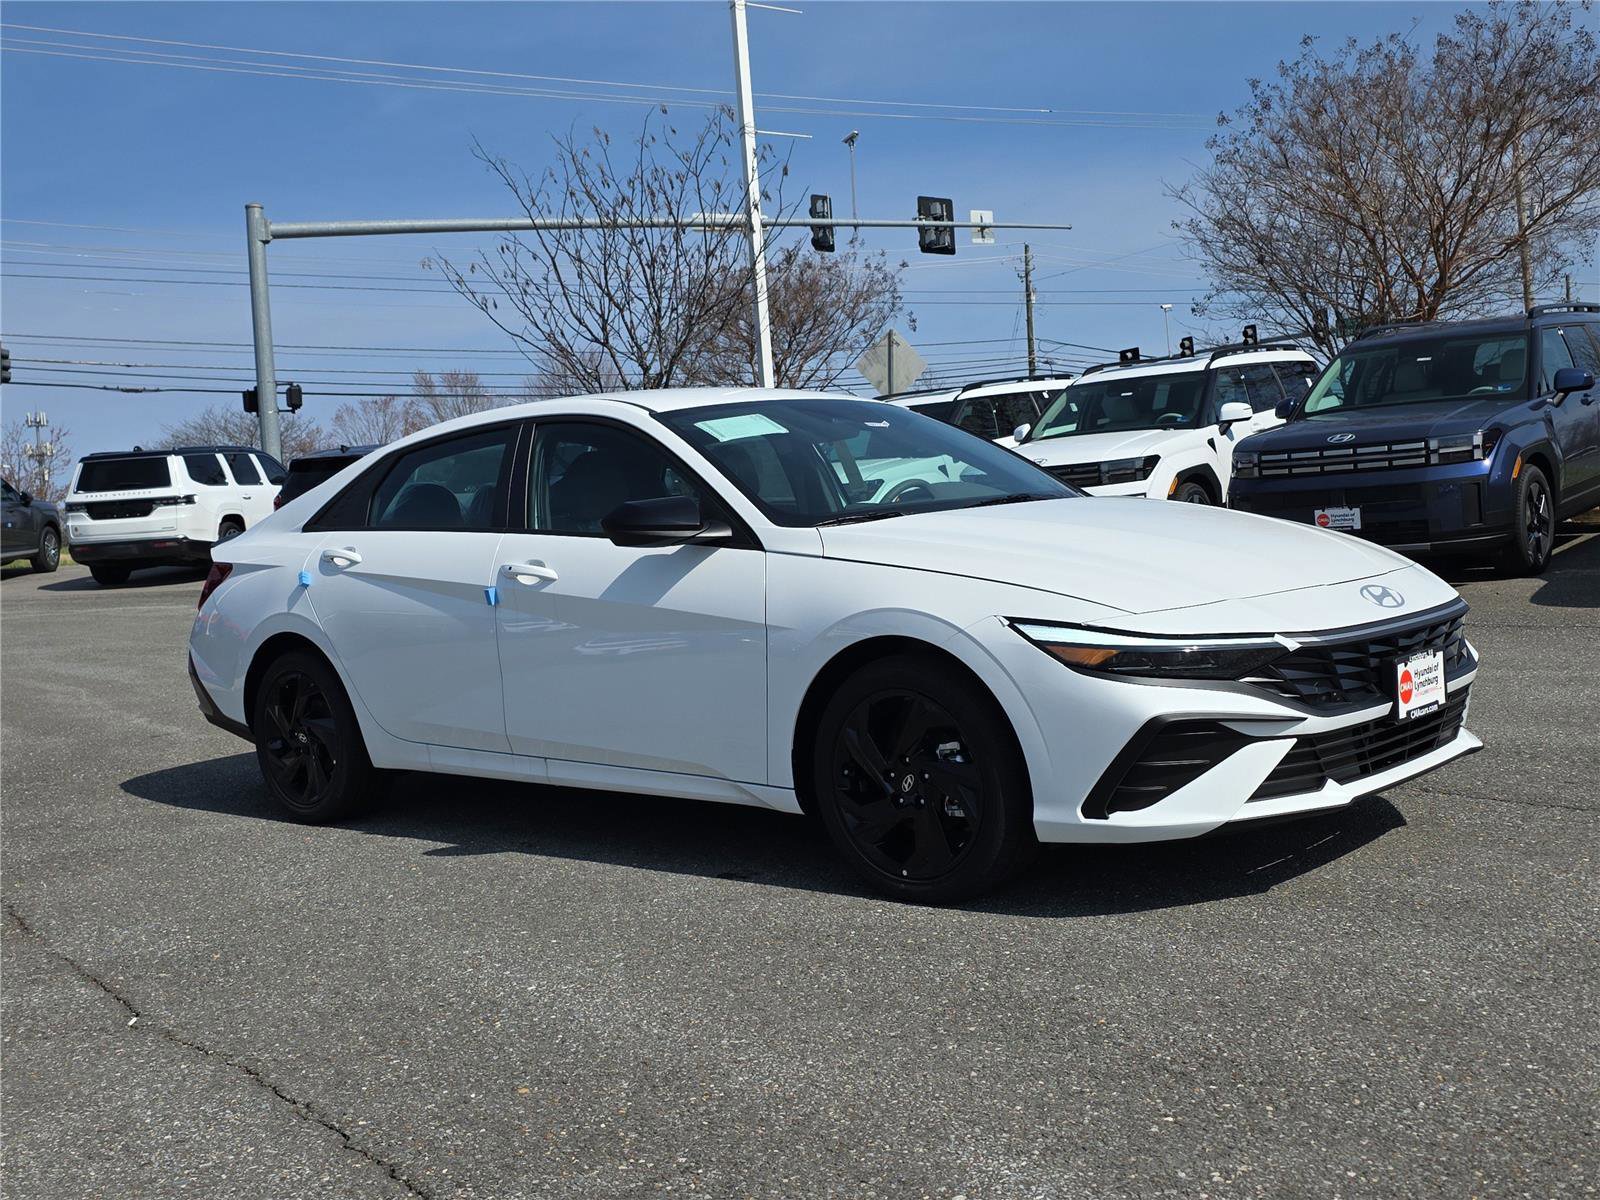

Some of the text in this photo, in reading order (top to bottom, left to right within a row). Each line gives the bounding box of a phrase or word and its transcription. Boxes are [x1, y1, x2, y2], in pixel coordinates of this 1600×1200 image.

[1414, 662, 1439, 679] Hyundai of
[1415, 676, 1438, 691] Lynchburg
